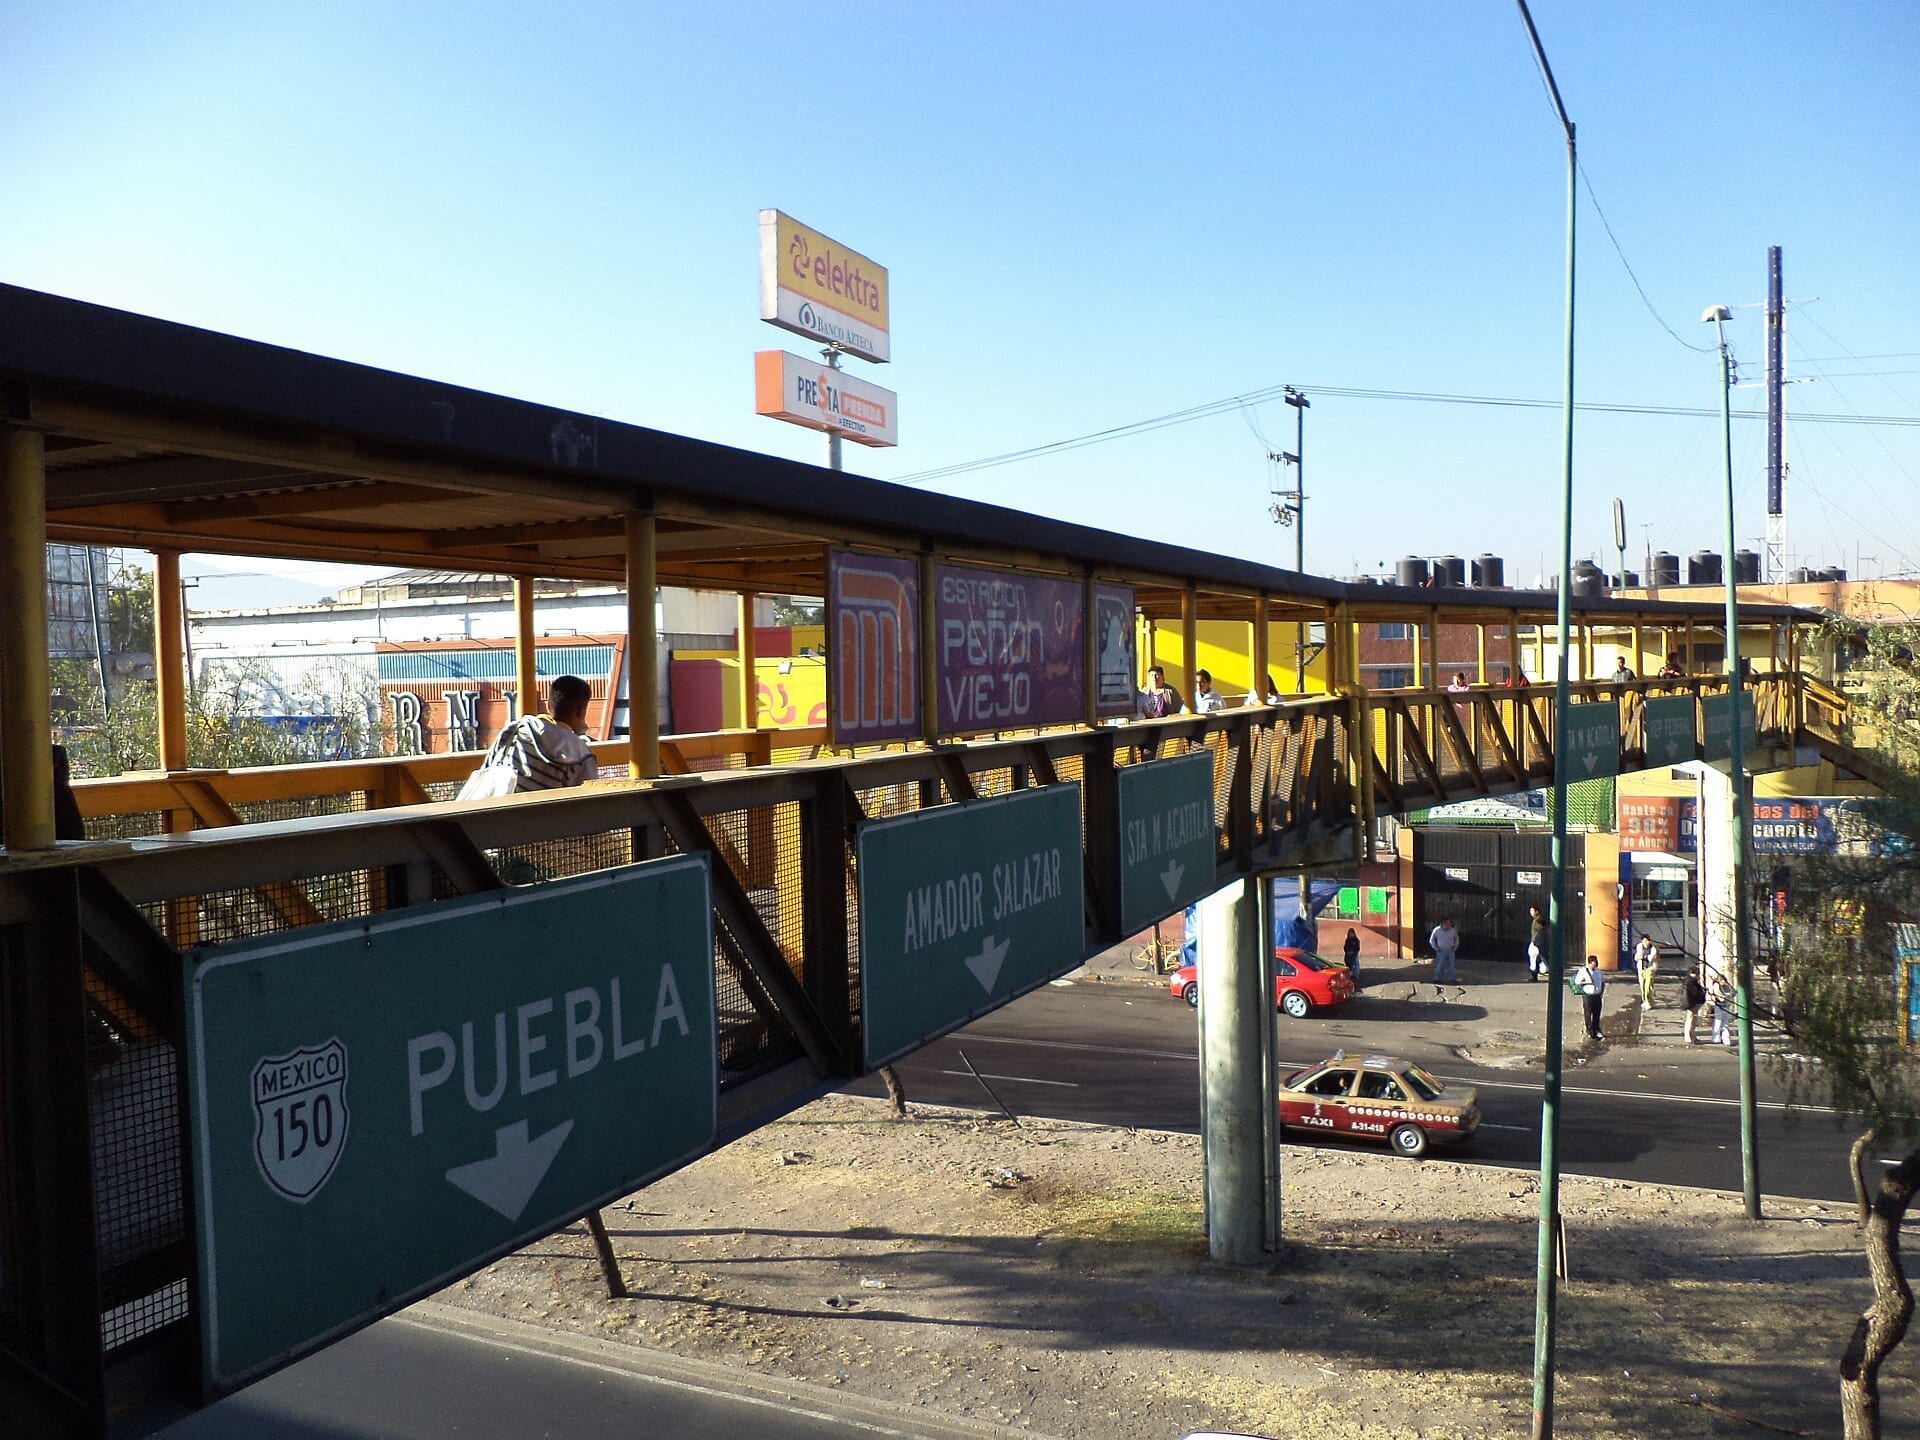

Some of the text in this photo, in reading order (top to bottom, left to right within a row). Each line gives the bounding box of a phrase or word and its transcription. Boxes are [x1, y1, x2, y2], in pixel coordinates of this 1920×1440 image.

[814, 250, 880, 313] elektra
[797, 371, 840, 414] PRESTA
[944, 672, 1031, 723] VIEJO
[1128, 818, 1147, 867] STA
[903, 848, 1061, 954] AMADOR SALAZAR
[262, 1052, 339, 1096] MEXICO
[406, 962, 690, 1137] PUEBLA
[273, 1093, 333, 1162] 150
[1301, 1115, 1334, 1128] TAXI
